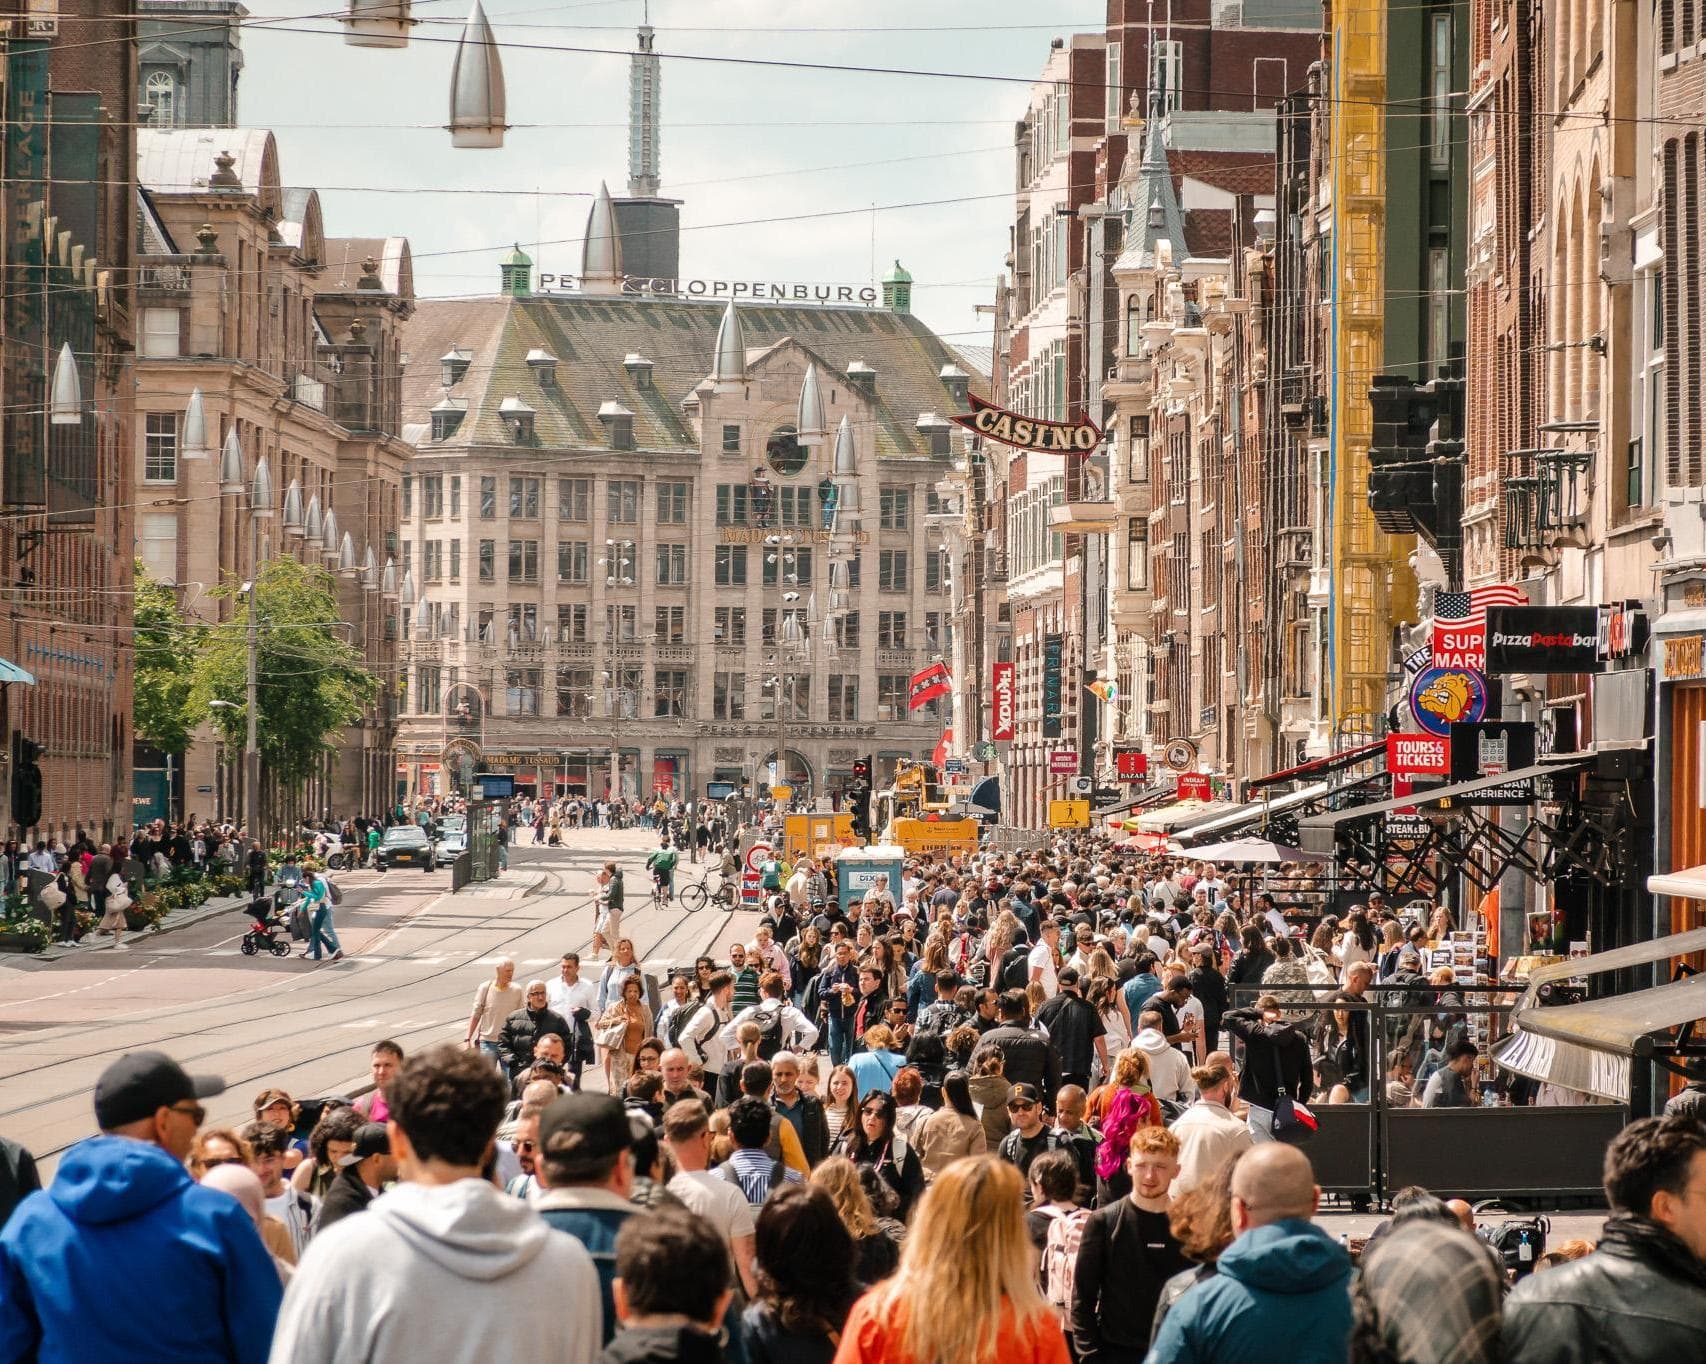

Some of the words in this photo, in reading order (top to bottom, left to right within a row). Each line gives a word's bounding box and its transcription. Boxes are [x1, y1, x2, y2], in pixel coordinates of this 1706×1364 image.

[649, 278, 877, 301] CLOPPENBURG
[975, 407, 1097, 450] CASINO
[1442, 633, 1485, 650] SUP
[1405, 647, 1433, 671] THE
[1046, 645, 1061, 726] PRIMARK
[486, 756, 521, 765] MADAME
[1396, 754, 1445, 767] TICKETS
[1385, 824, 1414, 834] STEAK
[1418, 824, 1431, 834] BU
[1014, 1085, 1024, 1097] P
